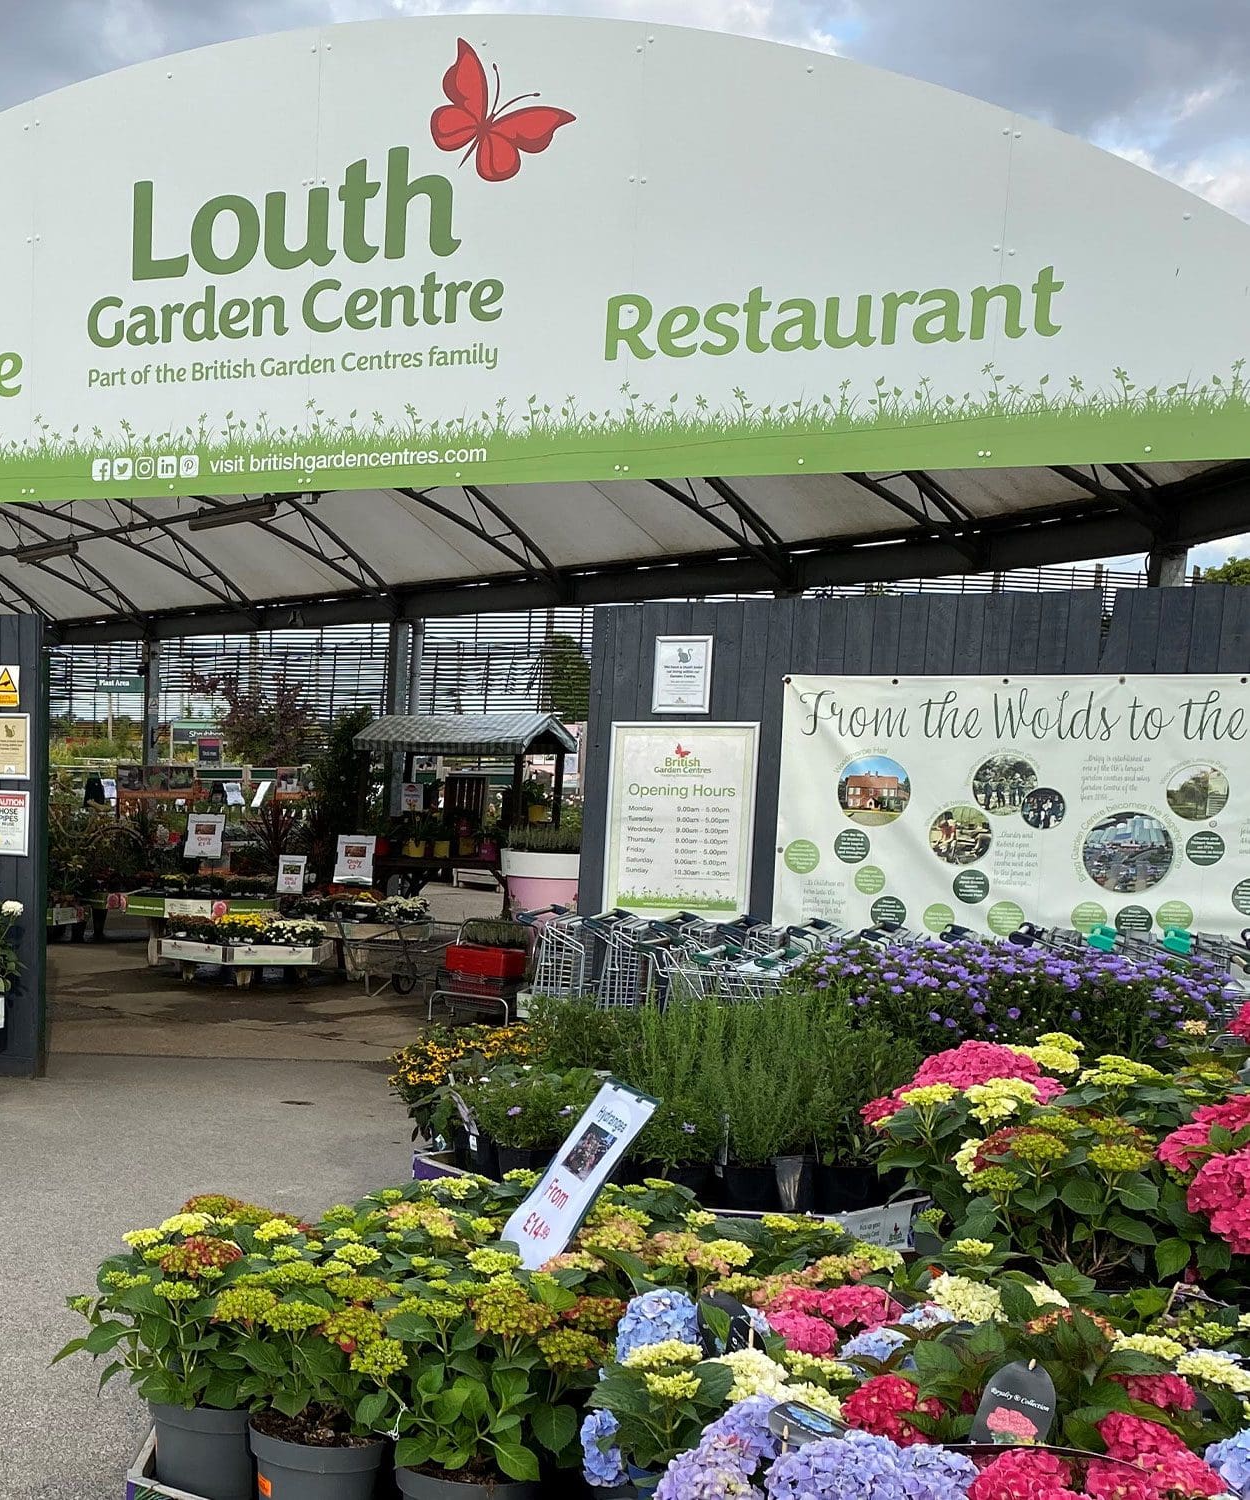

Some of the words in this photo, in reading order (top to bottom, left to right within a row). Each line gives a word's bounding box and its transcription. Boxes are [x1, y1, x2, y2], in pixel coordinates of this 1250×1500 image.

[132, 146, 462, 281] Louth
[87, 285, 288, 348] Garden
[302, 272, 504, 333] Centre
[604, 266, 1064, 361] Restaurant
[88, 368, 126, 387] Part
[130, 366, 151, 385] of
[155, 364, 186, 383] the
[191, 359, 256, 381] British
[260, 357, 336, 377] Garden
[341, 350, 423, 371] Centres
[427, 343, 499, 370] family
[209, 455, 245, 473] visit
[249, 448, 487, 472] britishgardencentres.com
[800, 690, 910, 738] From
[919, 690, 982, 739] the
[994, 688, 1121, 741] Wolds
[1128, 696, 1175, 741] to
[1179, 690, 1248, 741] the
[665, 757, 700, 767] British
[629, 783, 688, 799] Opening
[693, 784, 736, 797] Hours
[628, 815, 653, 823] Tuesday
[1070, 834, 1084, 860] Garden
[1080, 808, 1106, 831] Centre
[1106, 801, 1147, 812] becomes
[1149, 805, 1161, 816] the
[626, 856, 653, 864] Saturday
[597, 1105, 627, 1133] Hydrangea
[544, 1177, 569, 1210] From
[523, 1212, 550, 1240] £14.99
[1021, 1397, 1050, 1411] Collection
